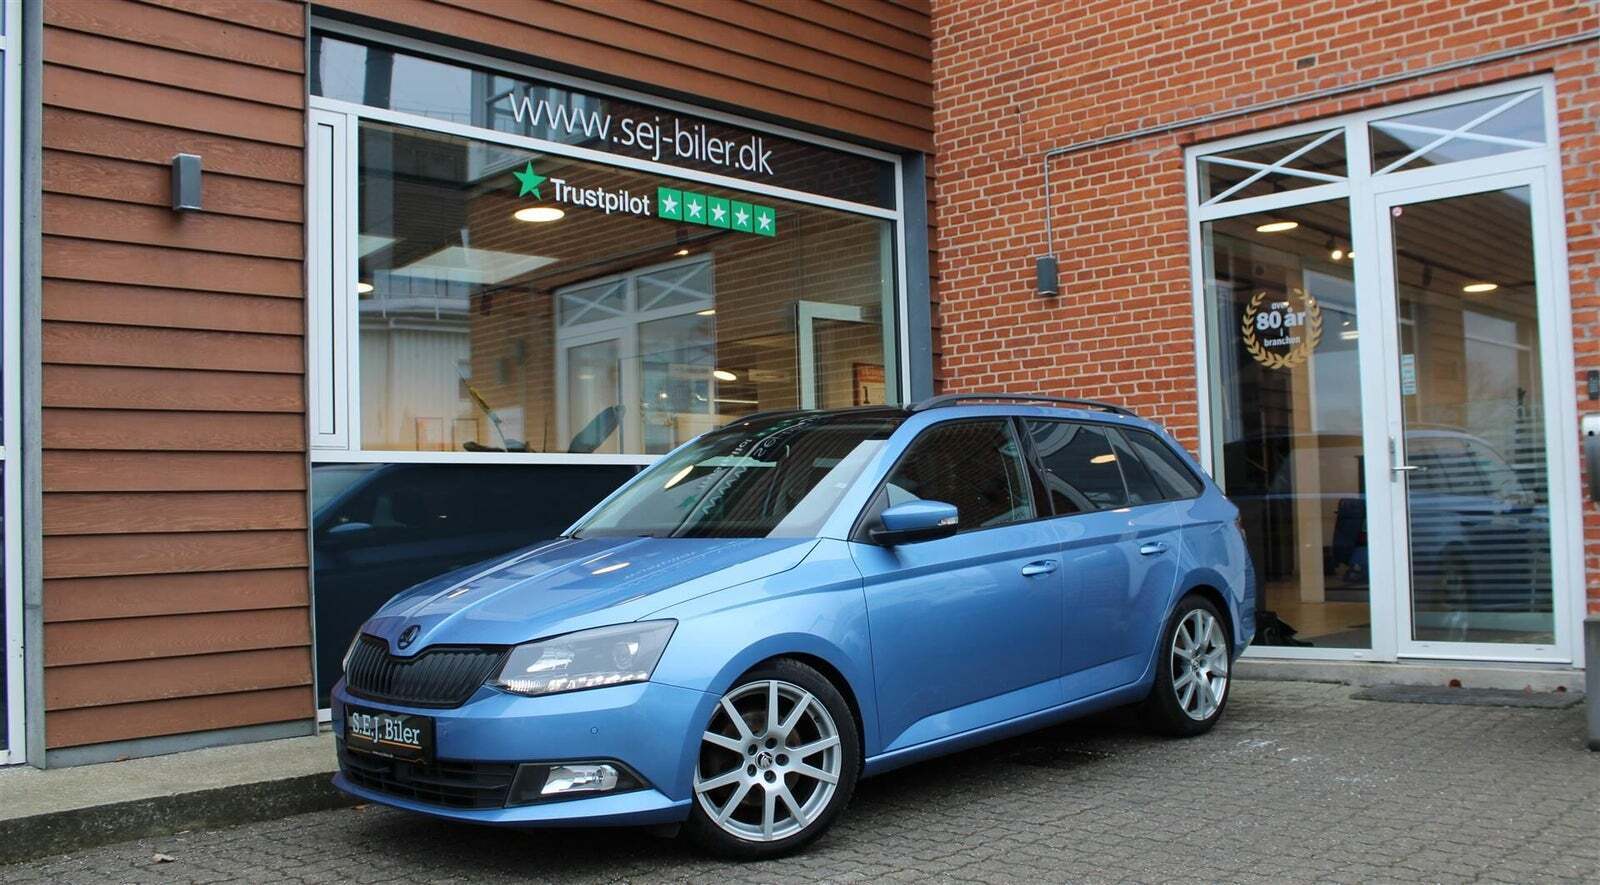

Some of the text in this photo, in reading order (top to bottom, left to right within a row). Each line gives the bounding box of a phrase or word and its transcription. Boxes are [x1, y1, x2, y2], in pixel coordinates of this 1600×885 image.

[509, 93, 774, 175] www.sej-biler.dk
[550, 178, 650, 216] Trustpilot
[1256, 307, 1306, 330] 80 år
[1264, 336, 1300, 347] branchen
[352, 712, 420, 744] S.E.J. Biler
